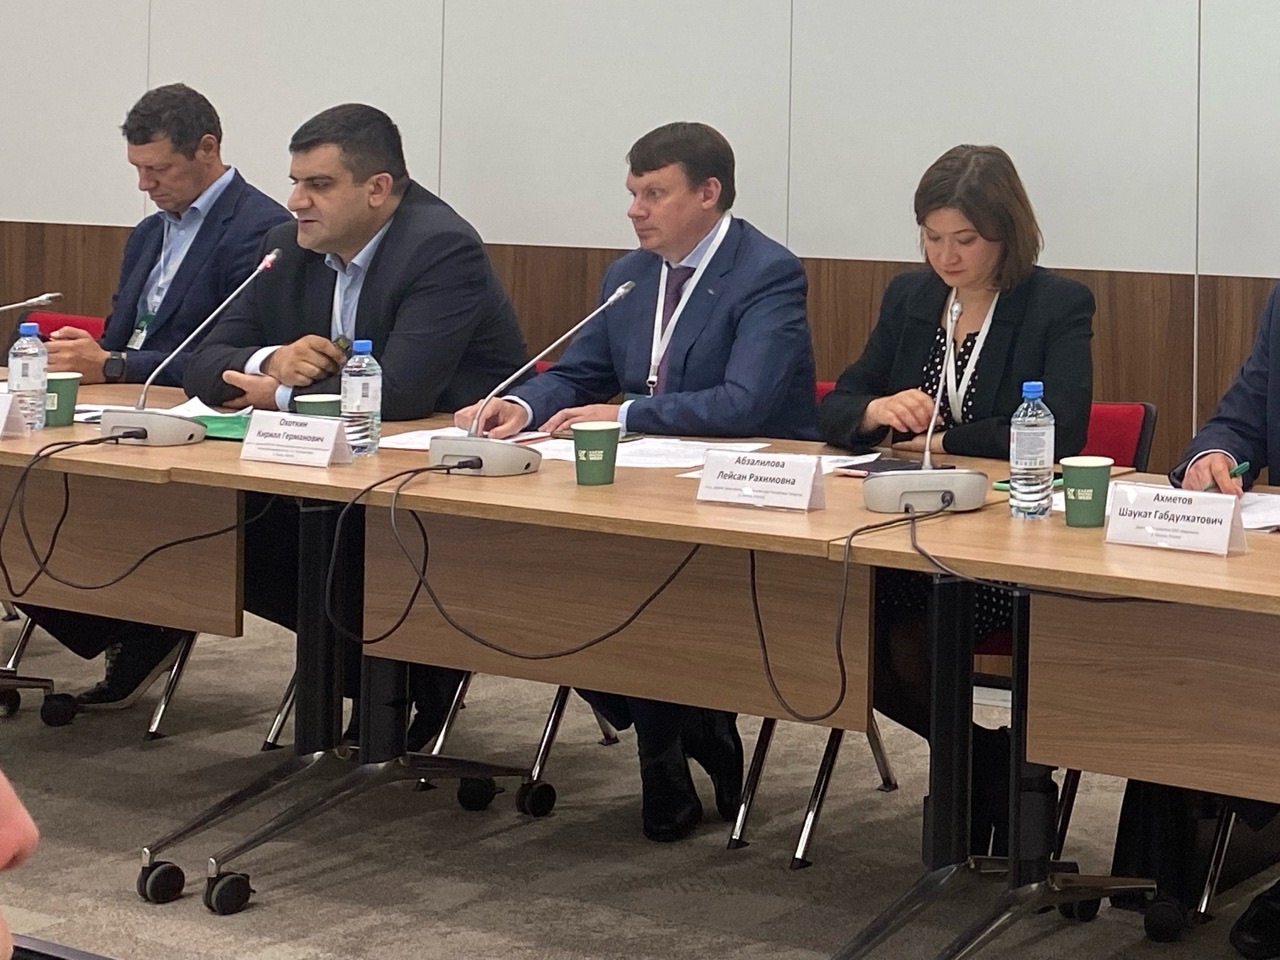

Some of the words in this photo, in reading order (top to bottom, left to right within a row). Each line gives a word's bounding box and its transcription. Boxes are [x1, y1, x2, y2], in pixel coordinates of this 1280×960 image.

[279, 418, 308, 427] Охоткин
[256, 430, 281, 439] Кирилл
[282, 432, 324, 442] Германович
[735, 456, 785, 468] Абзалилова
[717, 471, 747, 481] Лейсан
[748, 473, 796, 485] Рахимовна
[1153, 493, 1193, 505] Ахметов
[1118, 507, 1152, 519] Шаукат
[1153, 510, 1223, 525] Габдулхатович
